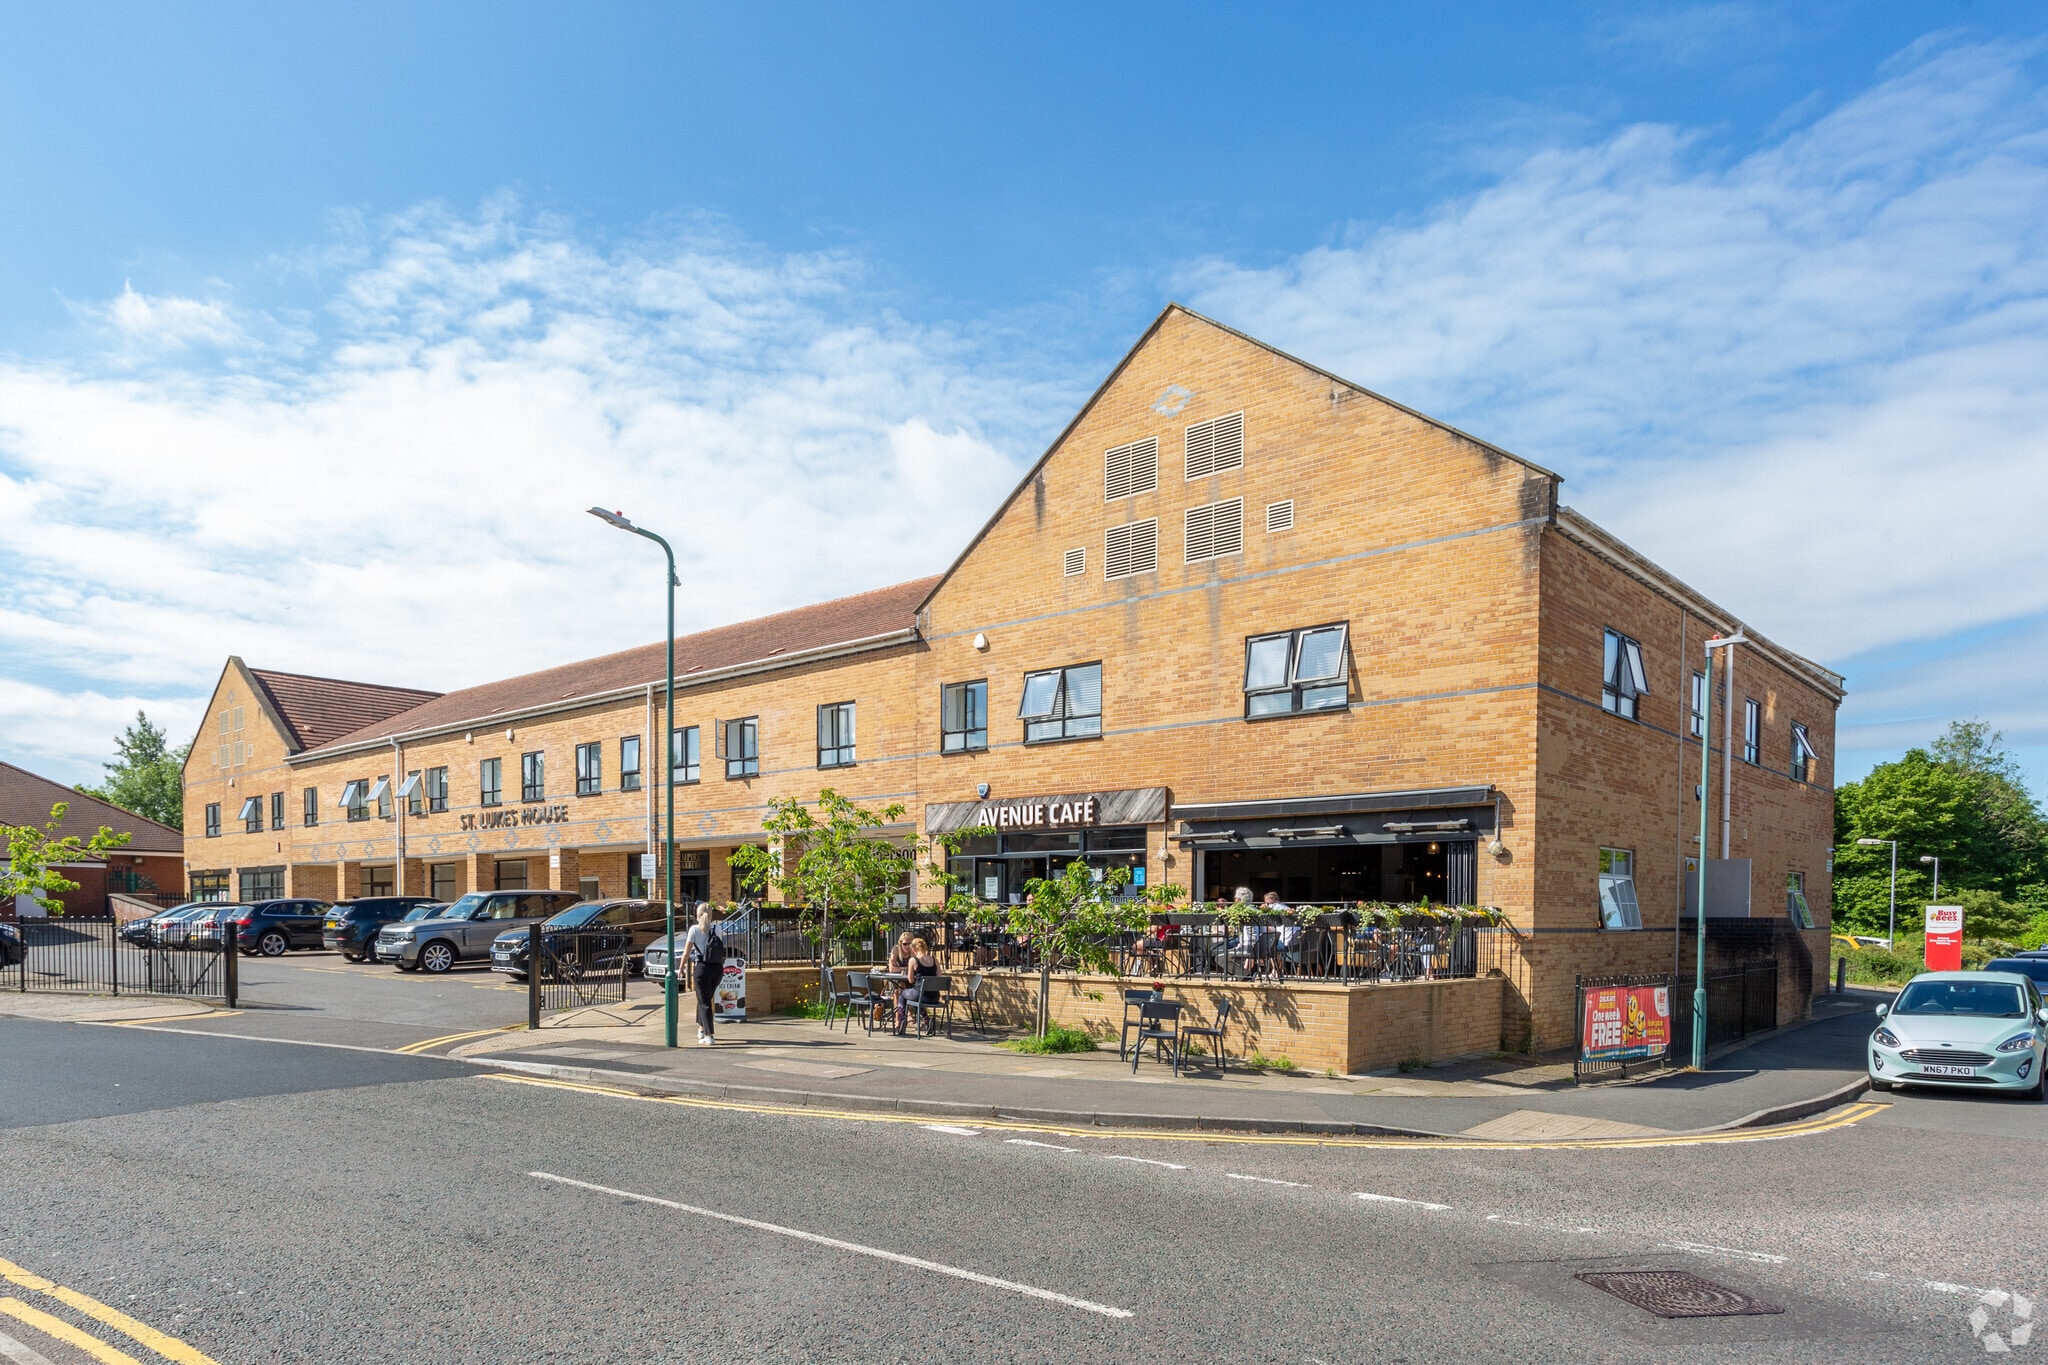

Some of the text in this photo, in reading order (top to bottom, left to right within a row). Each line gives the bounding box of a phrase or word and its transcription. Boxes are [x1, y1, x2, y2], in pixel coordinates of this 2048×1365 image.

[460, 804, 569, 831] ST. LUKES HOUSE
[977, 795, 1094, 827] AVENUE CAFÉ
[954, 884, 968, 892] Food
[1593, 1008, 1621, 1022] One week
[1592, 1021, 1622, 1048] FREE
[1923, 1065, 1970, 1075] WN67 PKO
